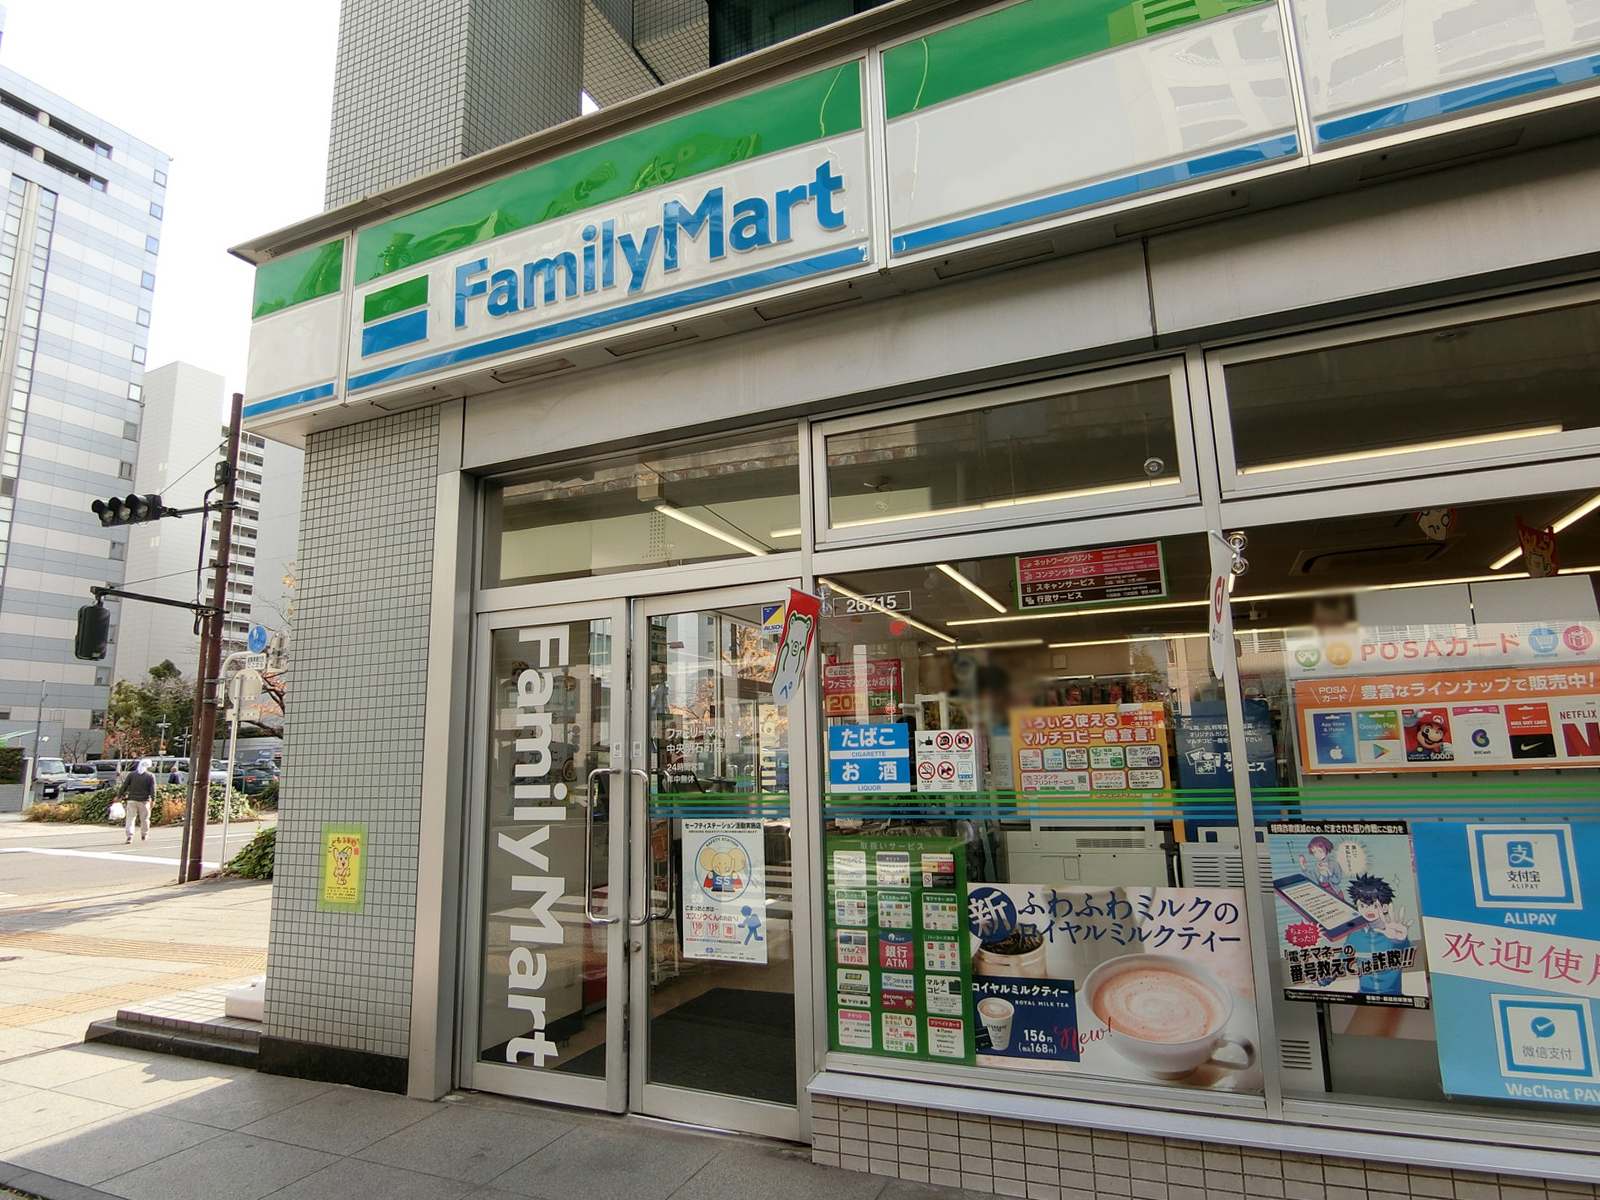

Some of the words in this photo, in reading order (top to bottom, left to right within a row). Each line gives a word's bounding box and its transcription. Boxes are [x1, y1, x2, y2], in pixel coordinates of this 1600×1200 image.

[454, 160, 846, 330] FamilyMart
[1034, 554, 1093, 566] ネットワークプリント
[1035, 566, 1095, 578] コンテンツサービス
[1036, 579, 1095, 591] スキャンサービス
[846, 595, 897, 613] 26715
[1036, 592, 1083, 603] 行政サービス
[1361, 633, 1519, 662] POSAカード
[1319, 686, 1348, 694] POSA
[1322, 695, 1346, 703] カード
[1020, 713, 1118, 729] いろいろ使える
[1559, 710, 1597, 720] NETFLIX
[666, 725, 730, 739] ファミリーマート
[1383, 722, 1397, 730] Play
[841, 726, 896, 747] たばこ
[1021, 728, 1156, 745] マルチコピー機宣言!
[666, 762, 705, 771] 24時間営業
[498, 624, 570, 1067] FamilyMart
[706, 837, 721, 847] SAFETY
[721, 837, 739, 847] STATION
[861, 842, 925, 850] 取扱いサービス
[715, 876, 731, 885] SS
[1507, 870, 1541, 883] 支付宝
[1018, 889, 1240, 925] ふわふわミルクの
[1504, 912, 1557, 925] ALIPAY
[1018, 921, 1241, 952] ロイヤルミルクティー
[1290, 926, 1314, 935] ちょっと
[885, 945, 908, 959] 銀行
[885, 958, 908, 968] ATM
[927, 979, 947, 987] マルチ
[927, 986, 948, 994] コピー
[972, 982, 1069, 998] ロイヤルミルクティー
[1023, 1029, 1053, 1043] 156円
[1053, 1016, 1113, 1055] New!
[1522, 1046, 1572, 1061] 微信支付
[1505, 1082, 1571, 1101] WeChat
